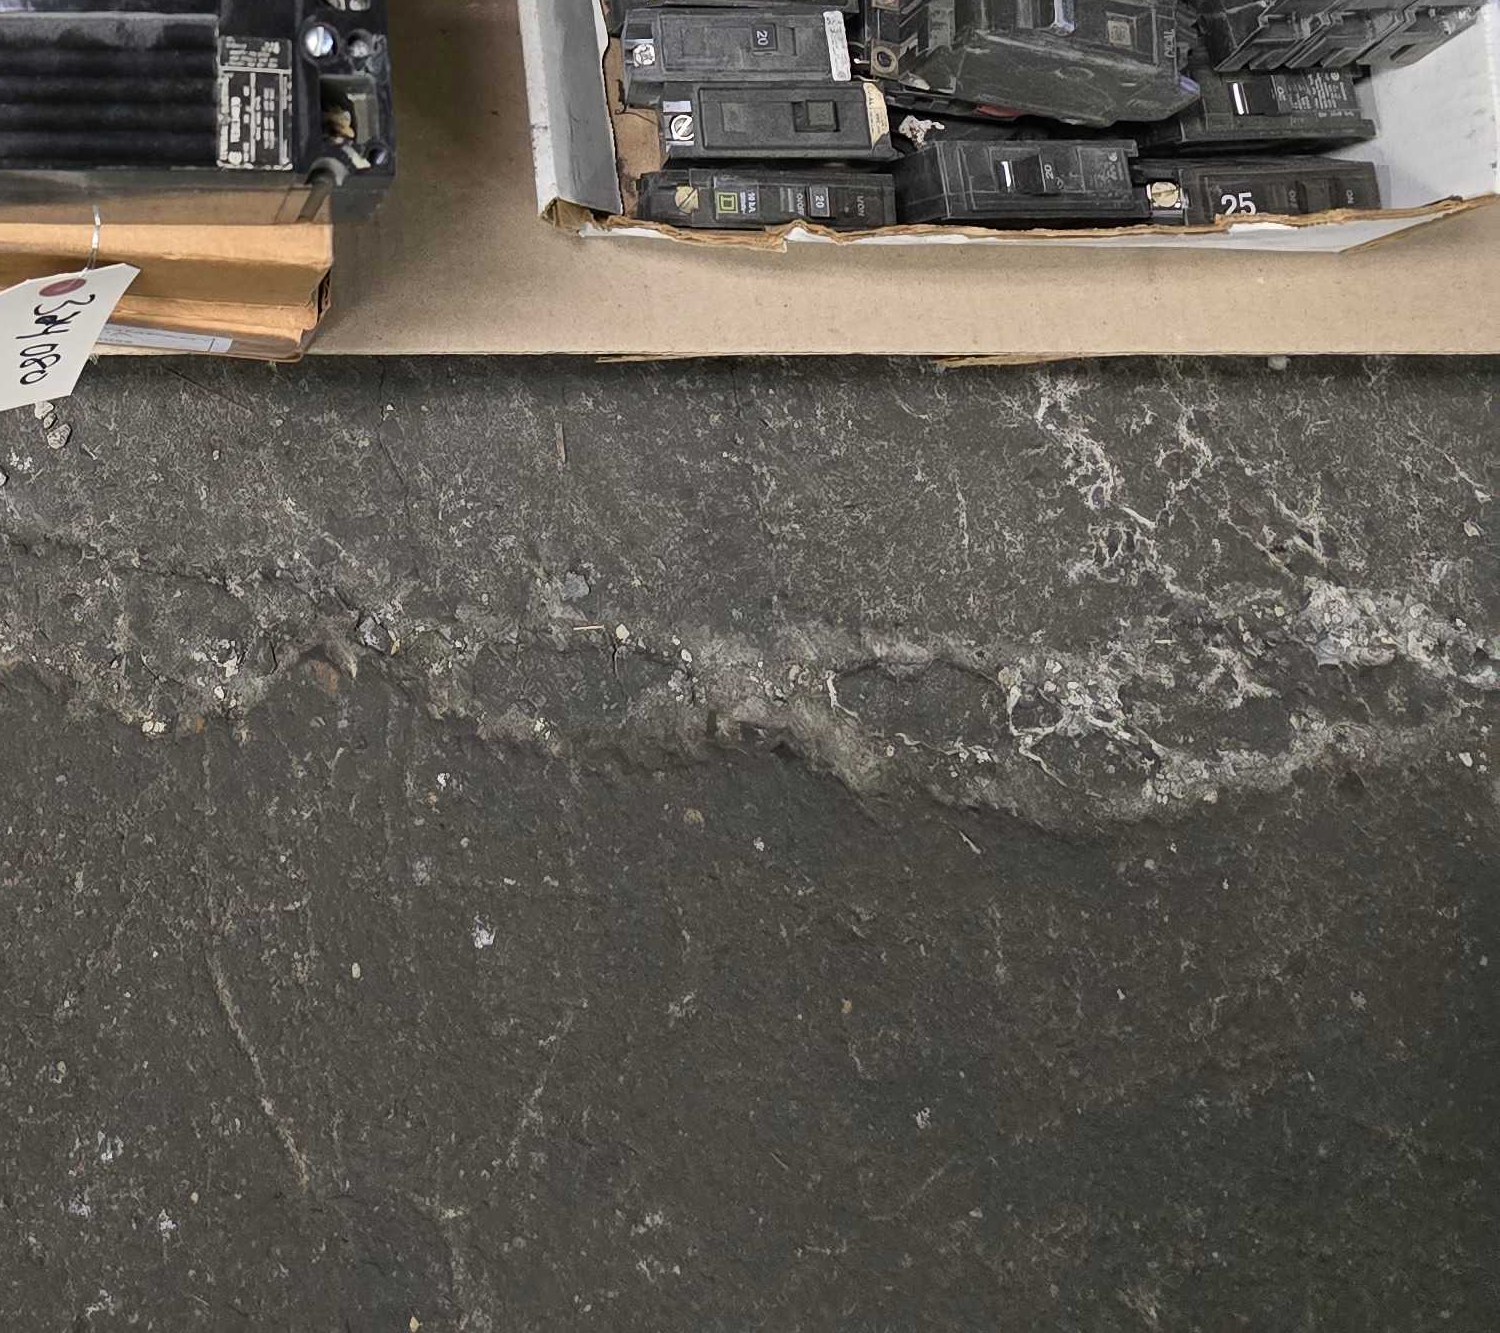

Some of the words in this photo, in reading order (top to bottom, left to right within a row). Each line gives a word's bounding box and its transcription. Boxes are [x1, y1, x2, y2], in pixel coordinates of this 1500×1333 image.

[756, 29, 769, 47] 20
[1044, 162, 1055, 181] 20
[813, 193, 825, 209] 20
[1220, 192, 1256, 215] 25
